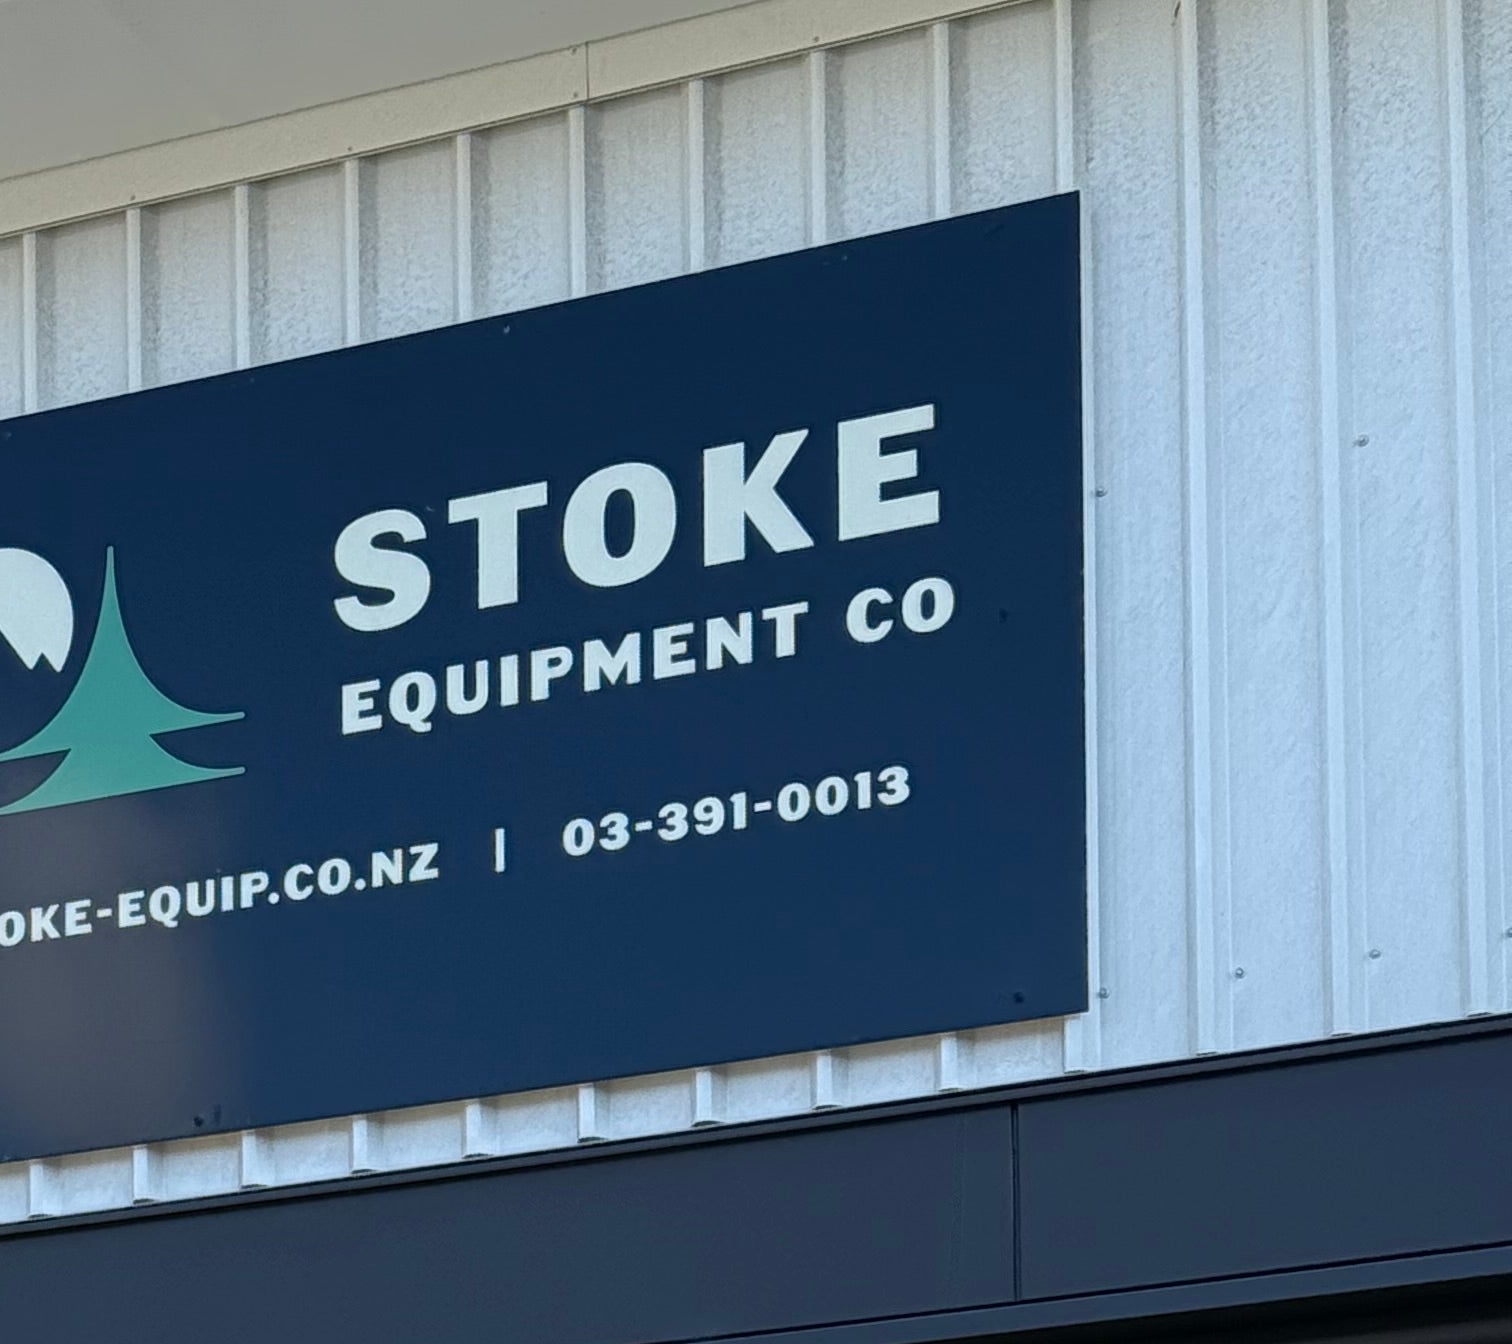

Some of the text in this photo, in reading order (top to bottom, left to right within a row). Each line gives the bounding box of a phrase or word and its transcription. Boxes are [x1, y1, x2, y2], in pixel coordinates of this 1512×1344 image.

[335, 404, 939, 631] STOKE
[342, 577, 955, 735] EQUIPMENT CO
[562, 765, 910, 857] 03-391-0013
